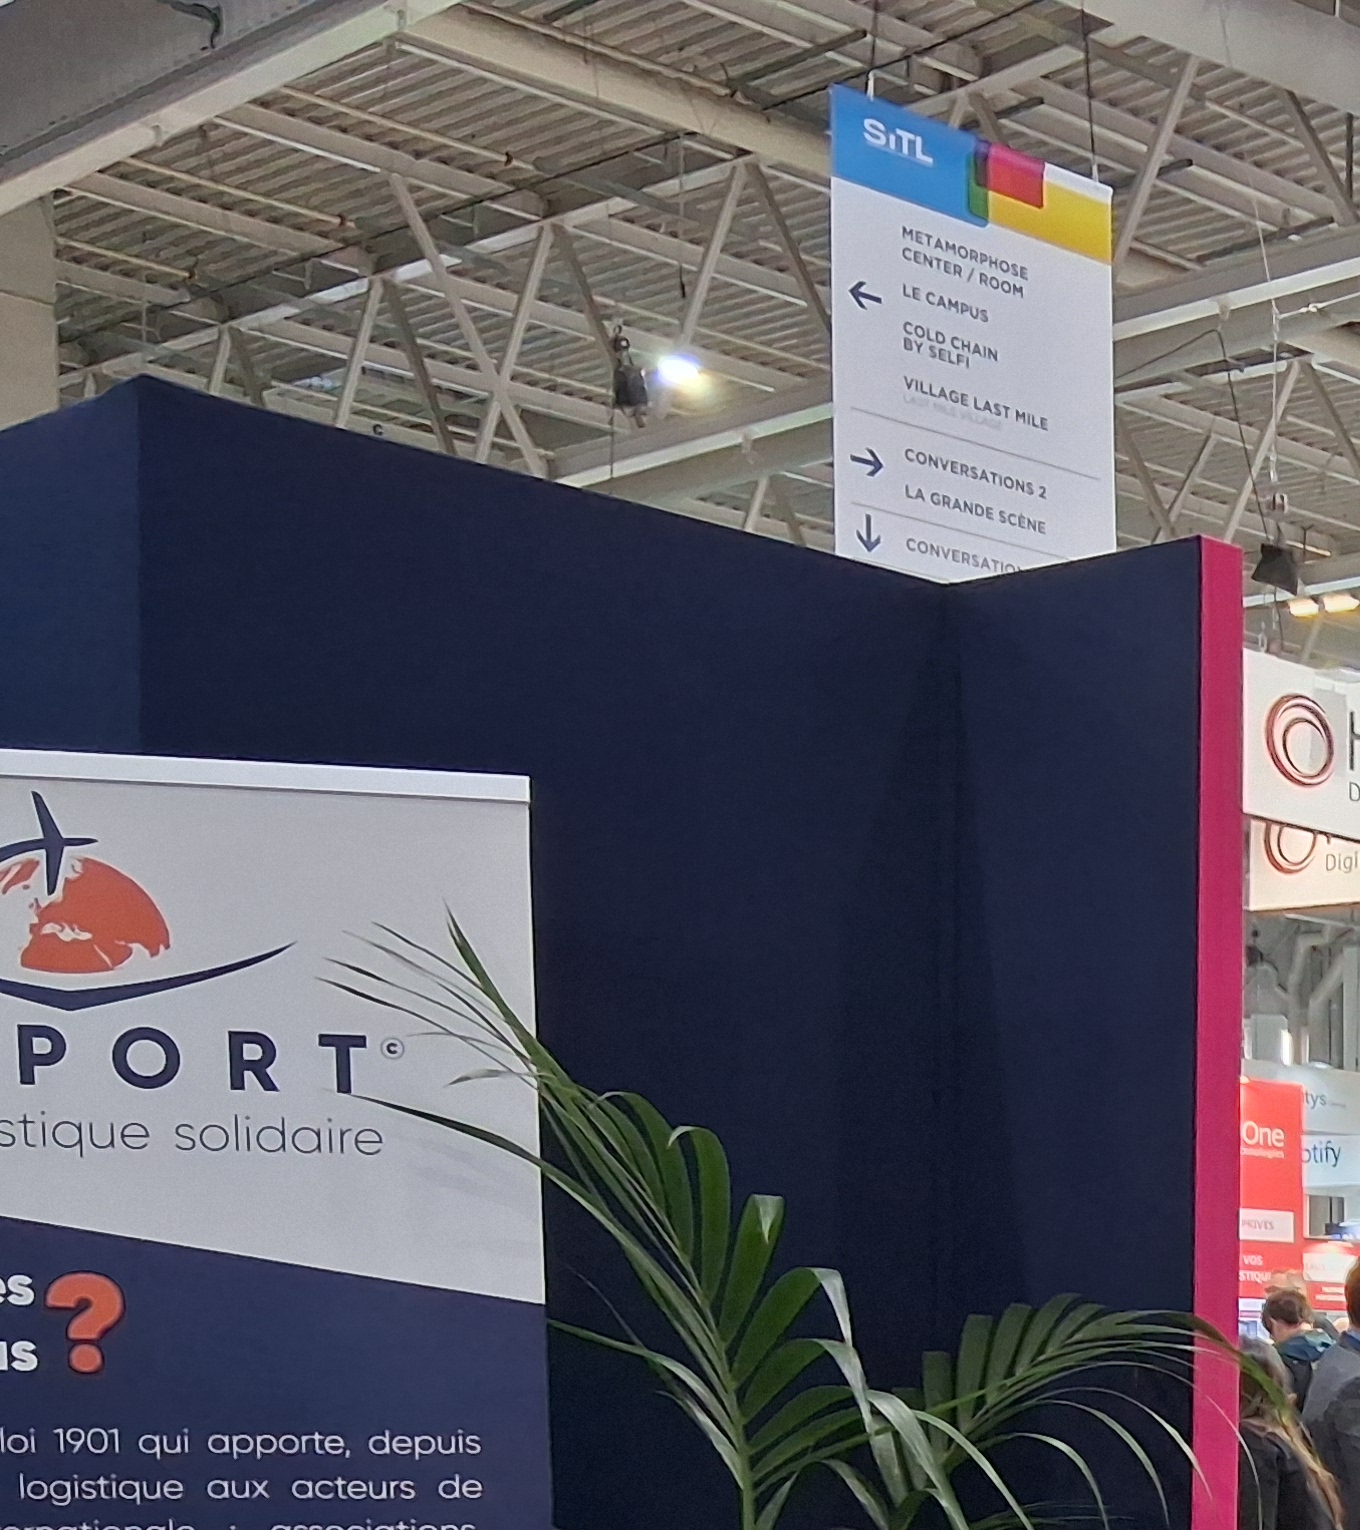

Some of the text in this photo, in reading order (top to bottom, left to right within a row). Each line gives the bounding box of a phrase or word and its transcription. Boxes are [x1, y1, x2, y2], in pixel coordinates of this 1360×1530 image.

[902, 226, 1029, 281] METAMORPHOSE
[902, 249, 963, 280] CENTER
[979, 271, 1024, 299] ROOM
[903, 283, 989, 323] LE CAMPUS
[903, 321, 999, 363] COLD CHAIN
[903, 337, 970, 370] BY SELFI
[903, 376, 969, 407] VILLAGE
[973, 396, 1010, 419] LAST
[1015, 409, 1048, 431] MILE
[904, 448, 1047, 500] CONVERSATIONS 2
[905, 484, 1046, 535] LA GRANDE SCÈNE
[174, 1113, 384, 1157] solidaire
[1242, 1120, 1285, 1148] One
[44, 1270, 126, 1374] ?
[0, 1427, 482, 1461] loi 1901 qui apporte, depuis
[18, 1474, 484, 1506] logistique aux acteurs de
